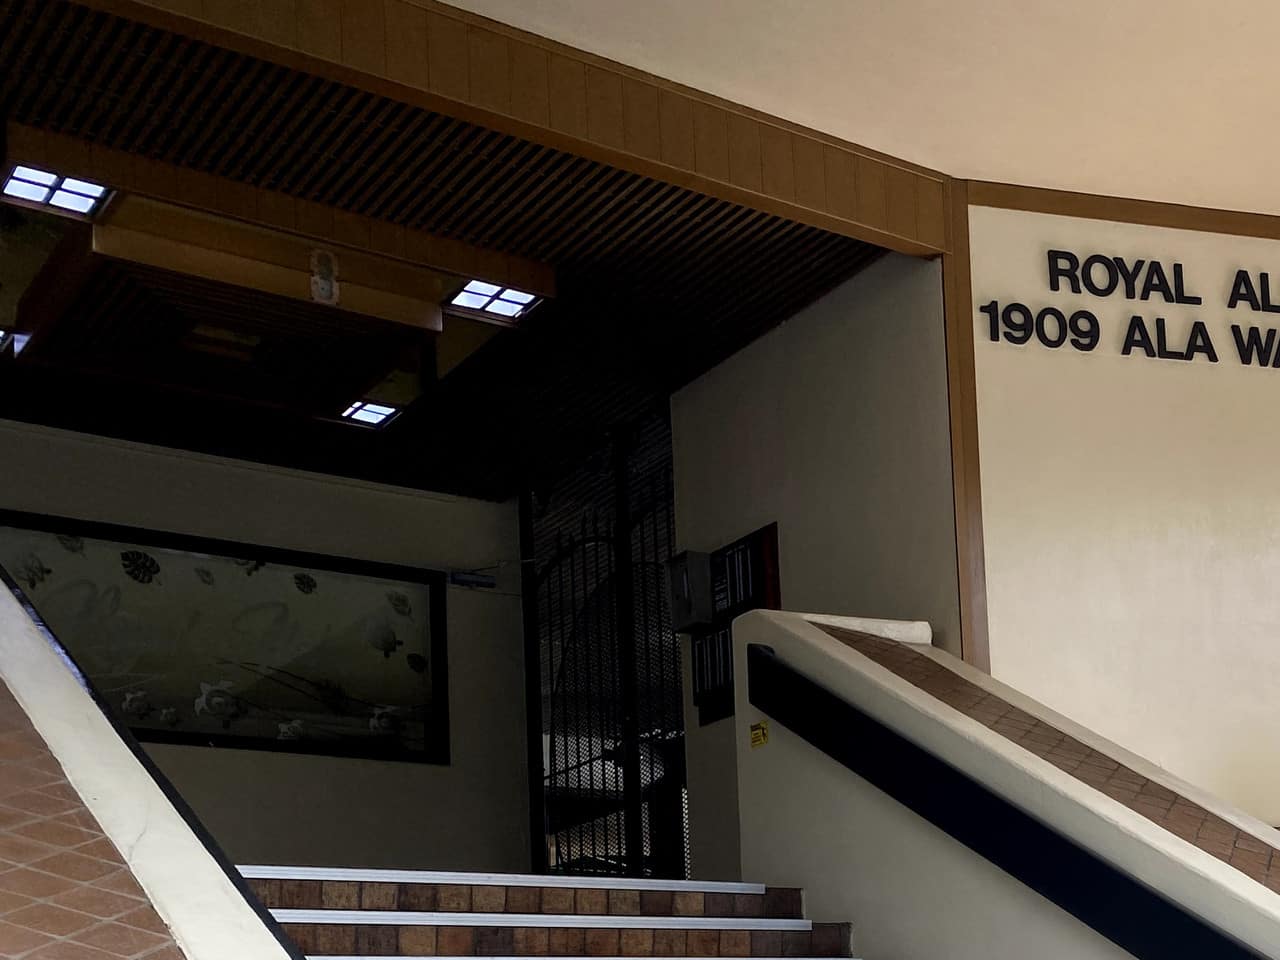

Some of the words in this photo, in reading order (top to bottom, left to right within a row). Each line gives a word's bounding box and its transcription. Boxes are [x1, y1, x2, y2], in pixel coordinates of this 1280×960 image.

[1047, 249, 1202, 305] ROYAL
[979, 300, 1100, 352] 1909
[1121, 315, 1219, 363] ALA
